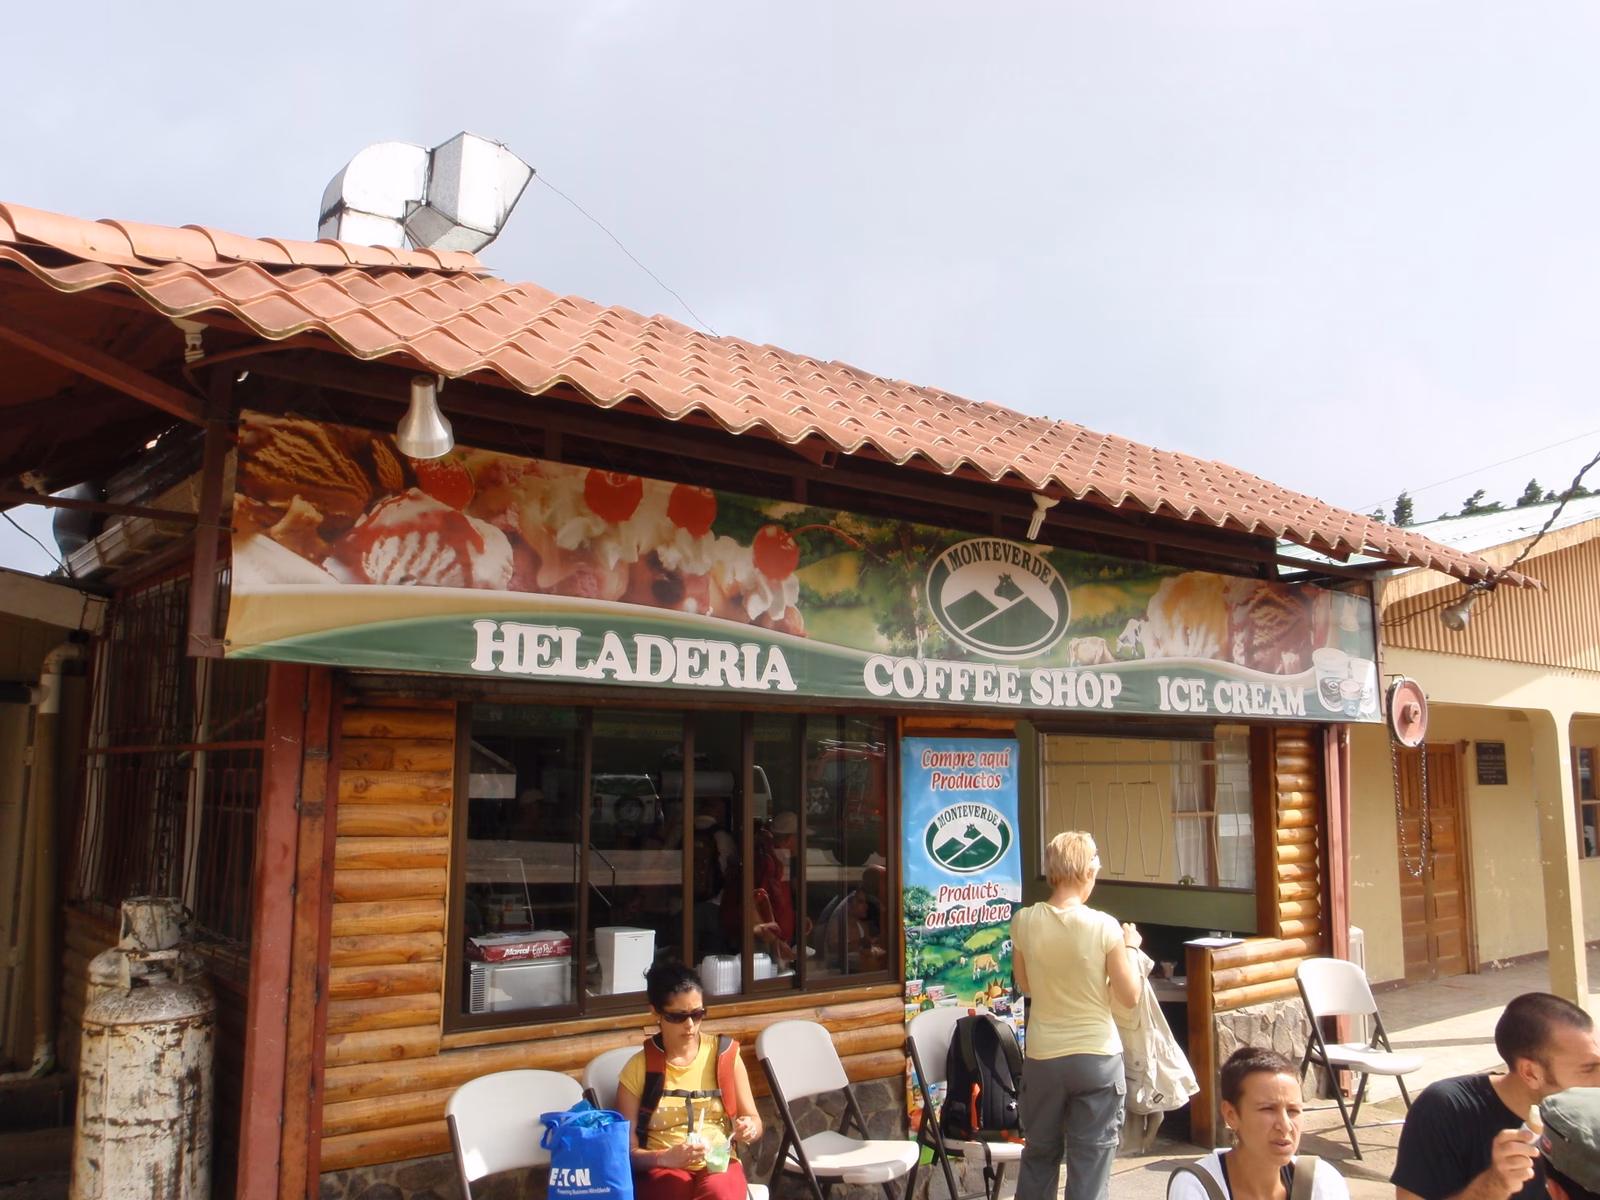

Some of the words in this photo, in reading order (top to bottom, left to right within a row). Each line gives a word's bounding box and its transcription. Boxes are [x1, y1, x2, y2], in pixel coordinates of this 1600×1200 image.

[947, 540, 1052, 585] MONTEVERDE
[471, 619, 798, 691] HELADERIA
[863, 654, 1022, 705] COFFEE
[1030, 667, 1122, 709] SHOP
[1157, 676, 1207, 712] ICE
[1213, 680, 1306, 716] CREAM
[922, 748, 976, 769] Compre
[978, 747, 1011, 769] aquí
[930, 771, 1002, 791] Productos
[937, 804, 999, 828] MONTEVERDE
[938, 881, 999, 904] Products
[926, 911, 945, 929] on
[948, 906, 978, 926] sale
[979, 903, 1011, 922] here
